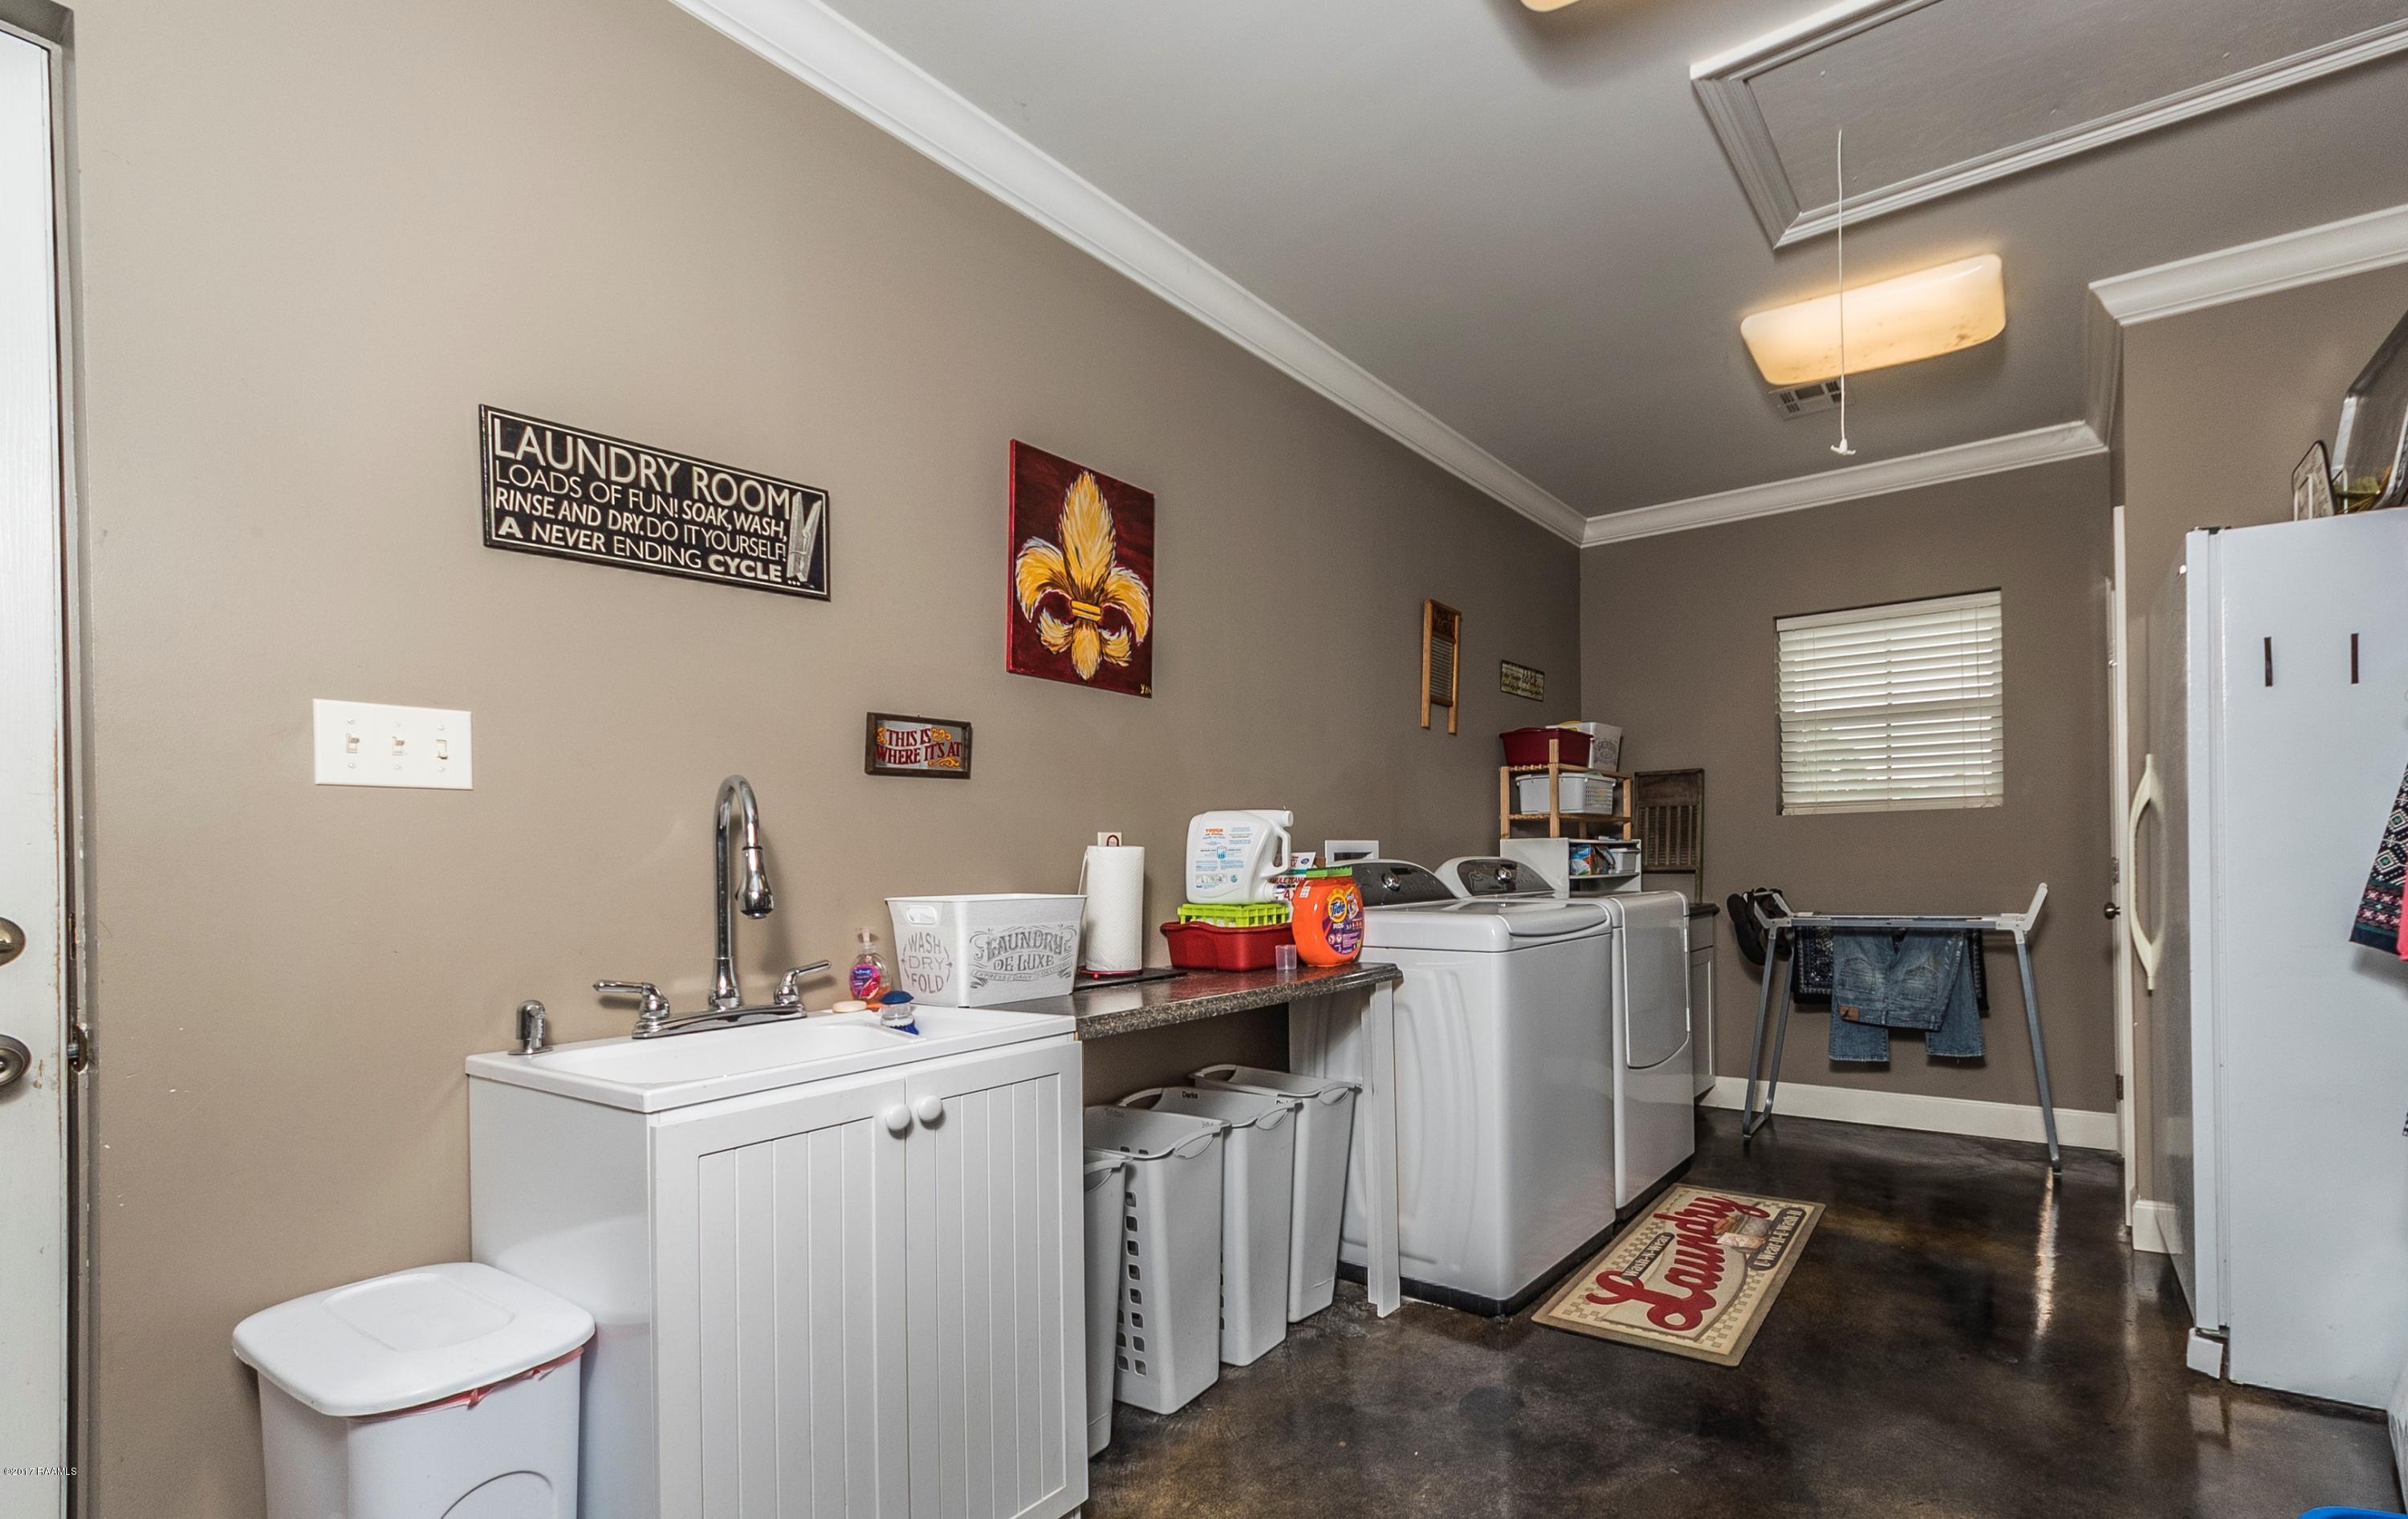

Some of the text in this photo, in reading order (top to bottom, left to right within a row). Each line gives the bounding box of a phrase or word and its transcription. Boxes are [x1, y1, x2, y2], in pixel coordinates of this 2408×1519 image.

[494, 418, 790, 519] LAUNDRY ROOM
[495, 460, 787, 541] LOADS OF FUN! SOAK, WASH,
[494, 487, 787, 561] RINSE AND DRY. DO IT YOURSELF!
[498, 515, 523, 538] A
[531, 521, 606, 552] NEVER
[613, 535, 702, 568] ENDING
[886, 727, 931, 747] THIS IS
[876, 744, 921, 765] WHERE
[947, 741, 962, 758] AT
[1330, 899, 1346, 916] Tide
[908, 931, 942, 955] WASH
[986, 929, 1066, 962] LAUNDRY
[909, 955, 946, 971] DRY
[993, 954, 1055, 972] DE LUXE
[911, 972, 944, 994] FOLD
[1584, 1195, 1771, 1331] Laundry
